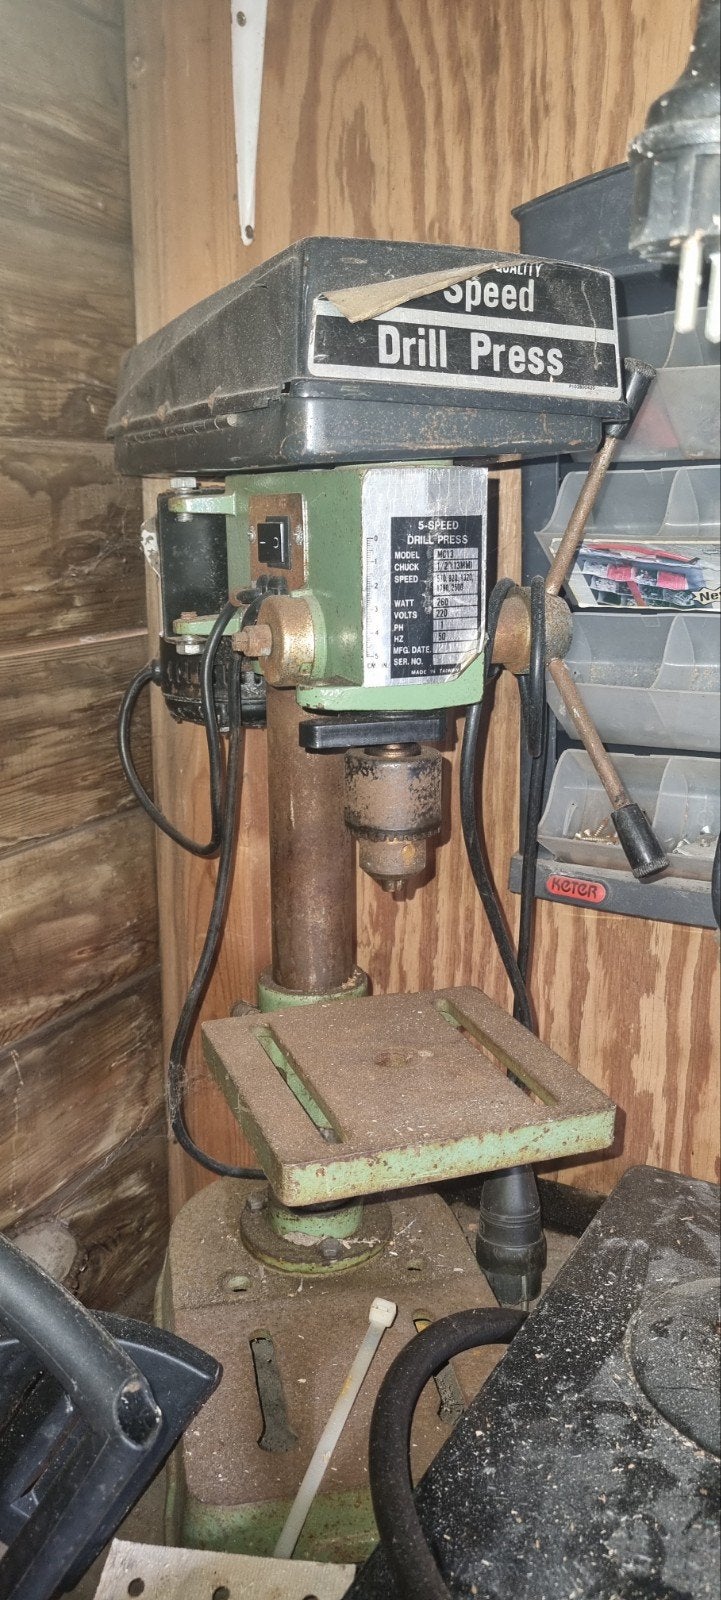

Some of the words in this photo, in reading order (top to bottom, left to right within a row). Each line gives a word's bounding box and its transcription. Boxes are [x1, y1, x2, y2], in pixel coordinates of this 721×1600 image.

[443, 278, 535, 313] Speed
[377, 324, 448, 369] Drill
[469, 332, 564, 377] Press
[418, 520, 459, 530] 5-SPEED
[407, 535, 434, 545] DRILL
[437, 534, 468, 544] PRESS
[394, 551, 420, 559] MODEL
[437, 549, 454, 559] MC13
[394, 563, 420, 571] CHUCK
[394, 575, 419, 583] SPEED
[394, 599, 414, 608] WATT
[436, 598, 449, 606] 260
[699, 591, 720, 605] Ne
[393, 611, 418, 619] VOLTS
[436, 609, 448, 617] 220
[393, 635, 404, 643] HZ
[438, 632, 446, 641] 50
[393, 646, 410, 654] MFG.
[393, 658, 410, 666] SER.
[411, 657, 424, 665] NO.
